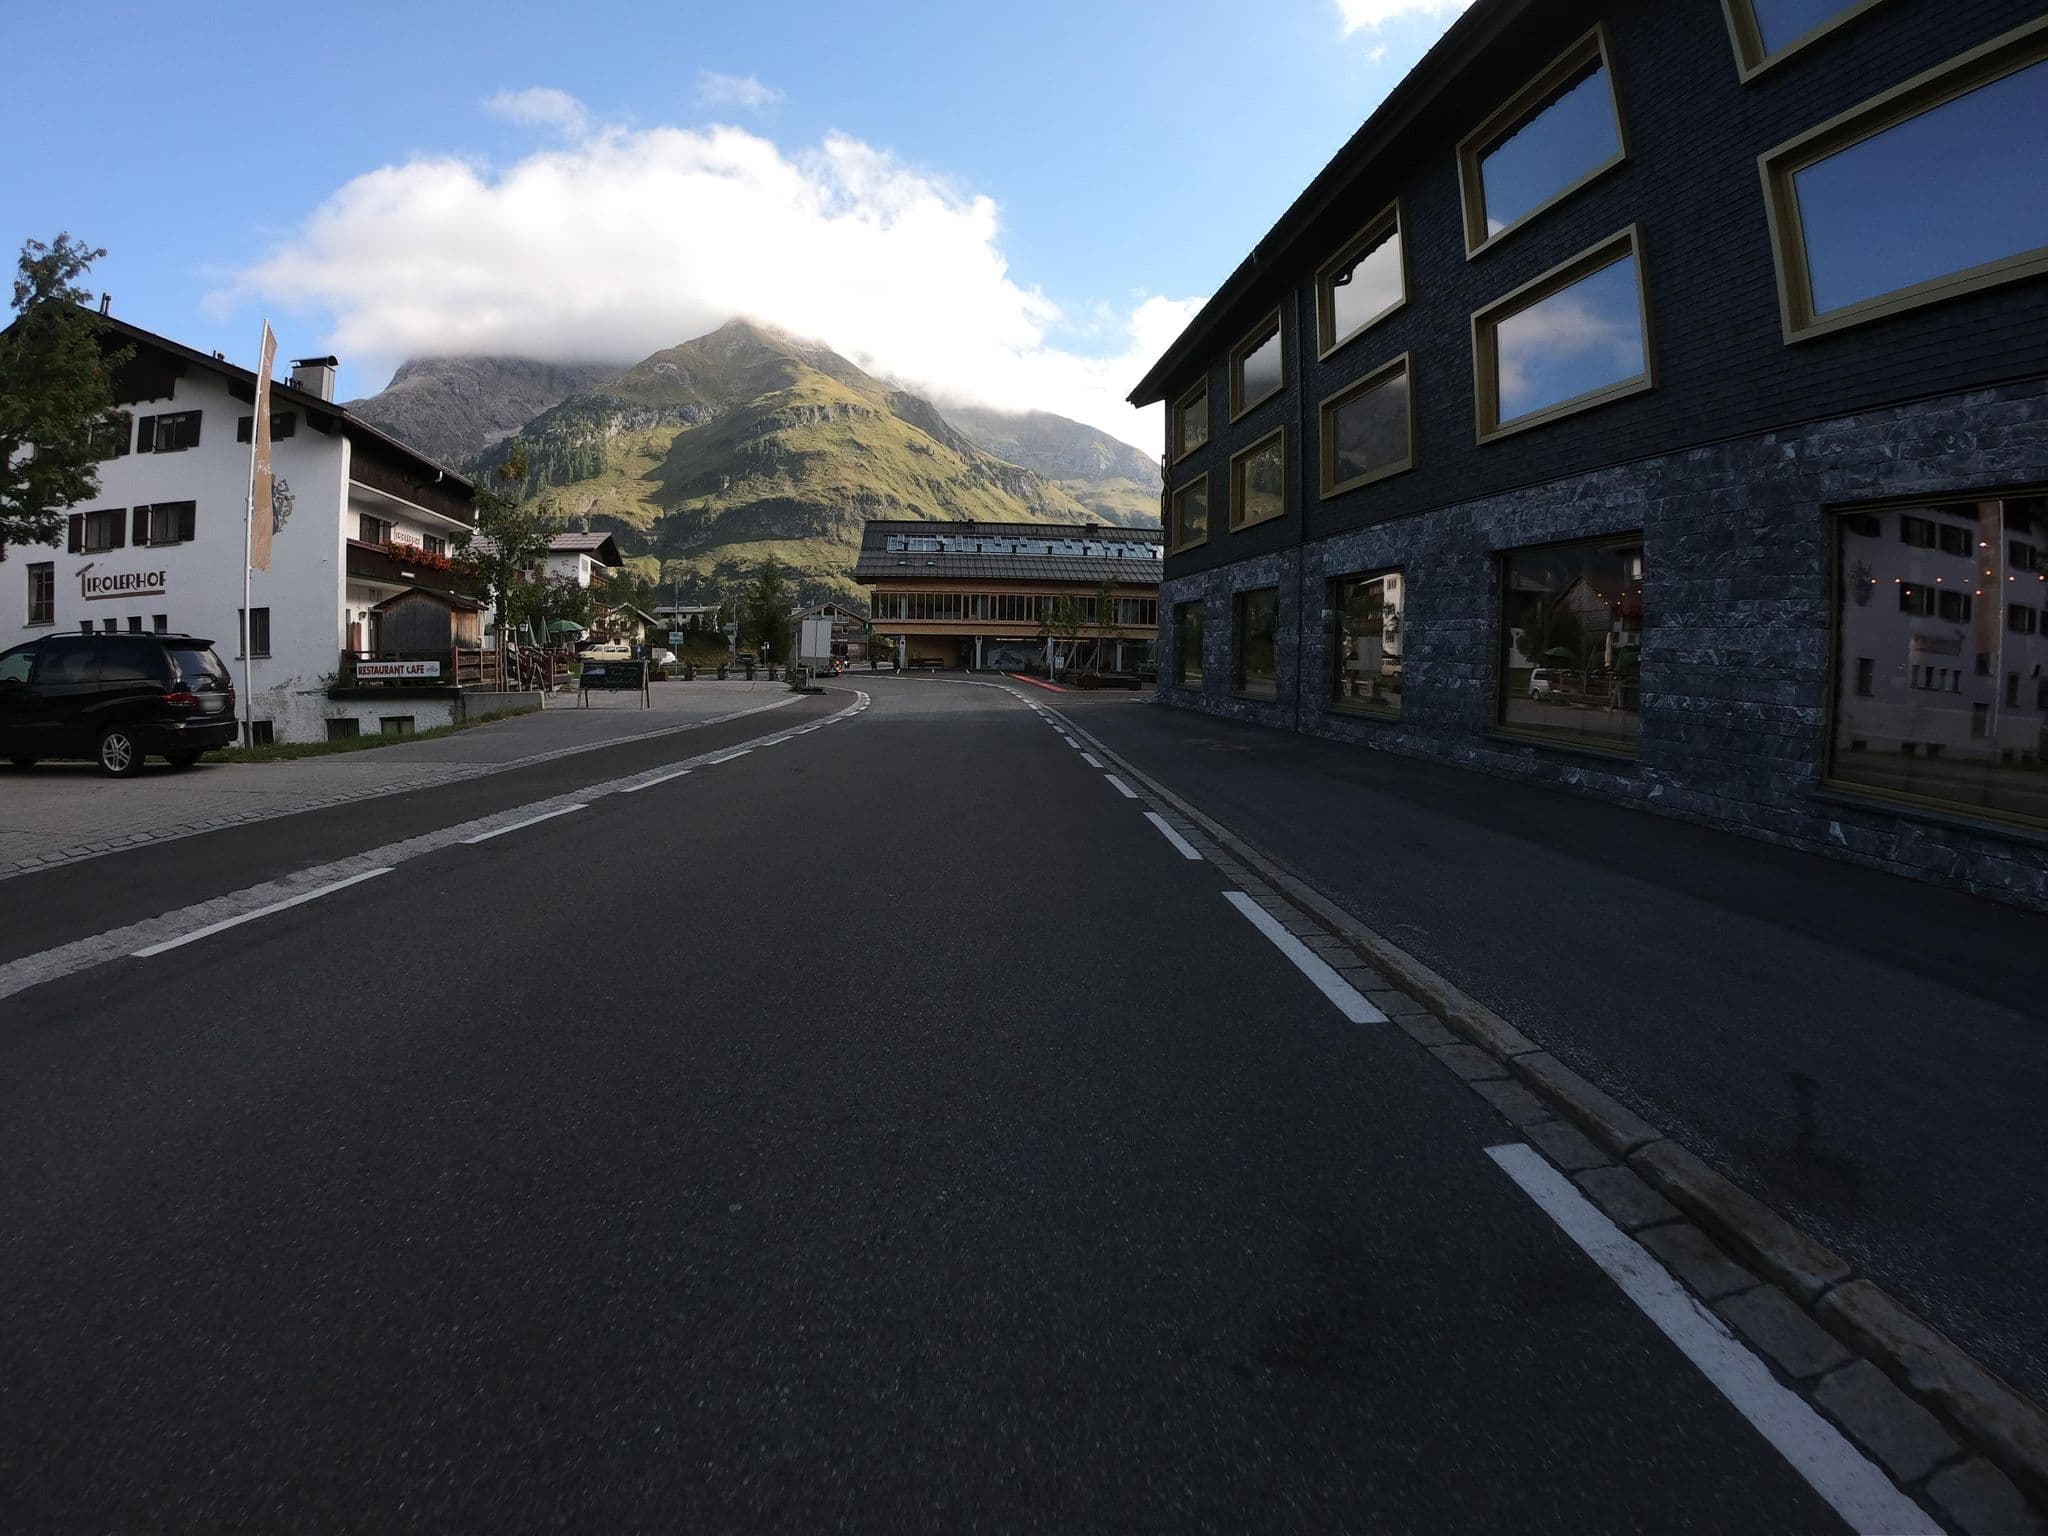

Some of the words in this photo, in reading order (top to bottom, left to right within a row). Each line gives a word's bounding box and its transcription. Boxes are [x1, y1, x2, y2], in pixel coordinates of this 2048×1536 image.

[75, 562, 166, 597] TIROLERHOF
[358, 665, 404, 675] RESTAURANT
[406, 664, 425, 674] CAFE
